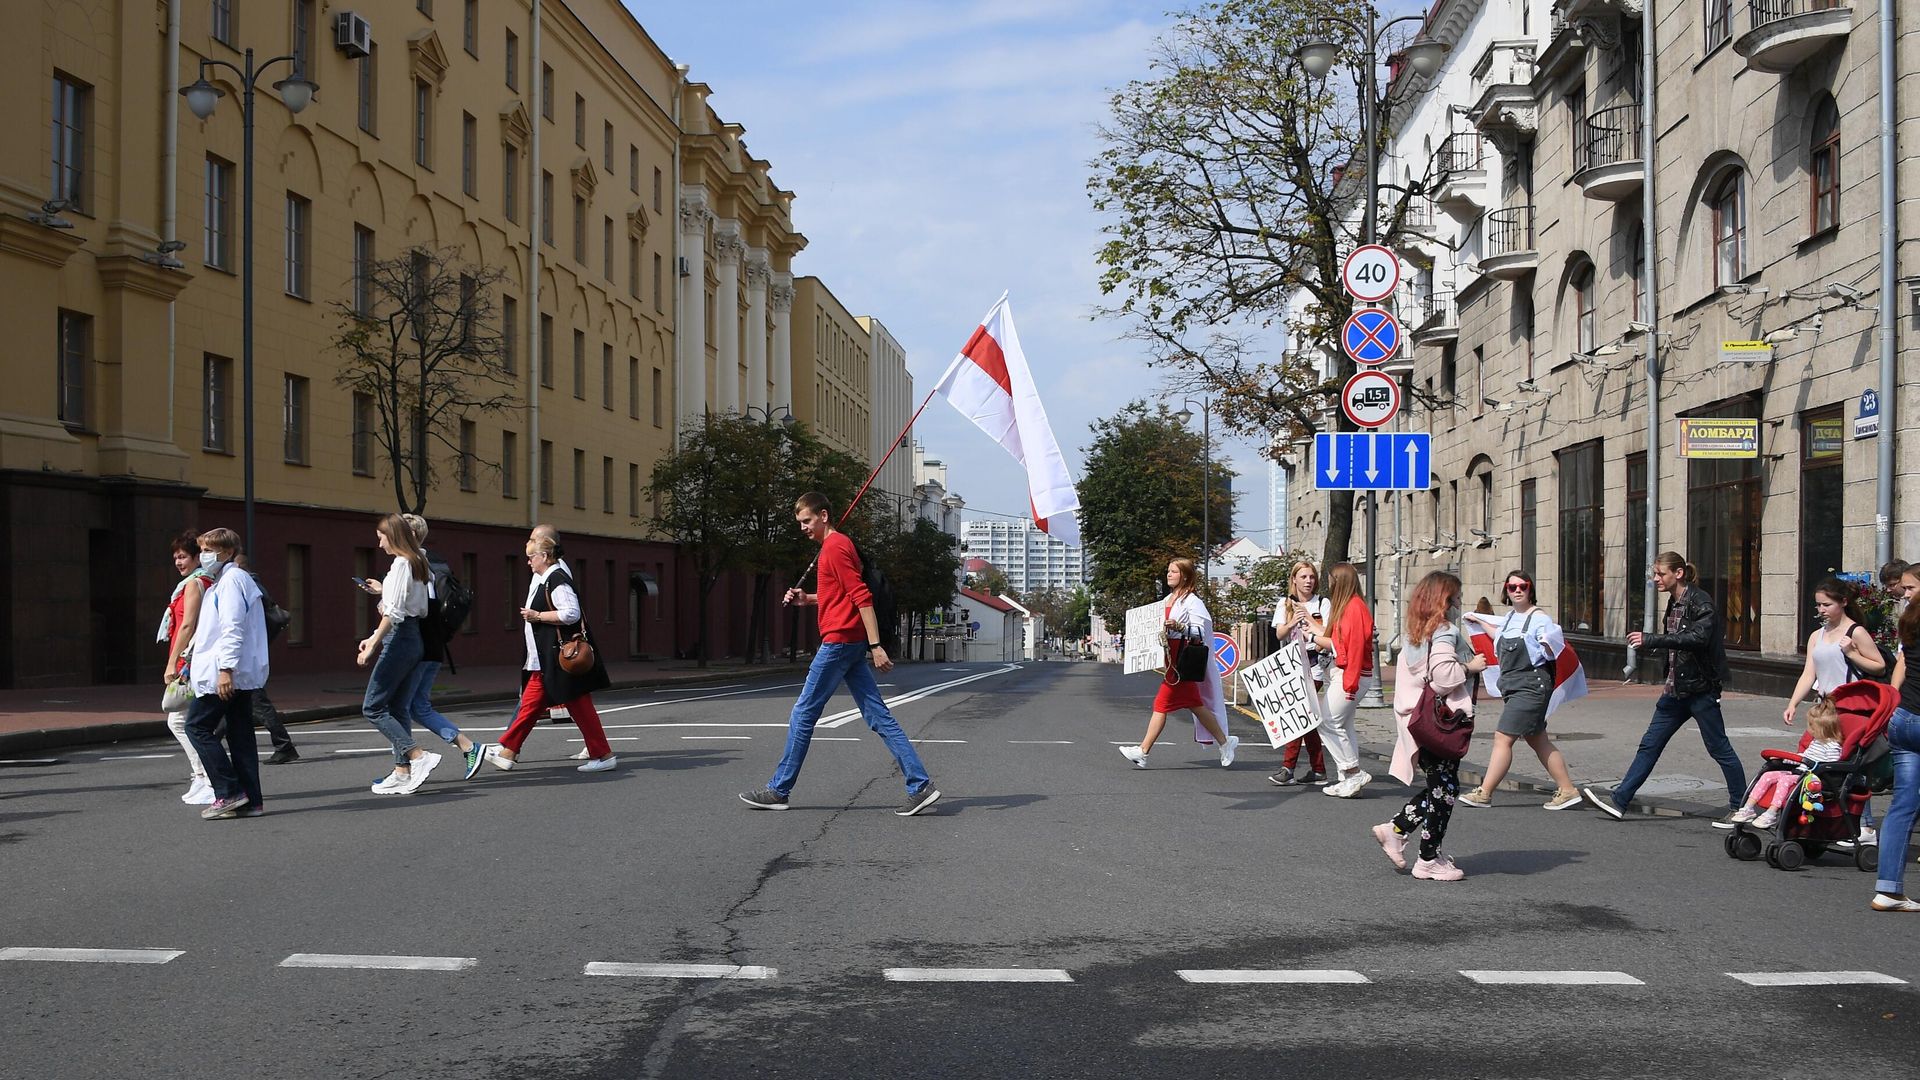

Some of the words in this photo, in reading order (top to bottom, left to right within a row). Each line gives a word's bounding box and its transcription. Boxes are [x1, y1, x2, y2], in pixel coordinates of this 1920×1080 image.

[1355, 263, 1386, 283] 40
[1863, 392, 1876, 411] 23
[1689, 427, 1754, 440] ЛОМБАРД
[1131, 653, 1157, 672] ПЕТЛЯ
